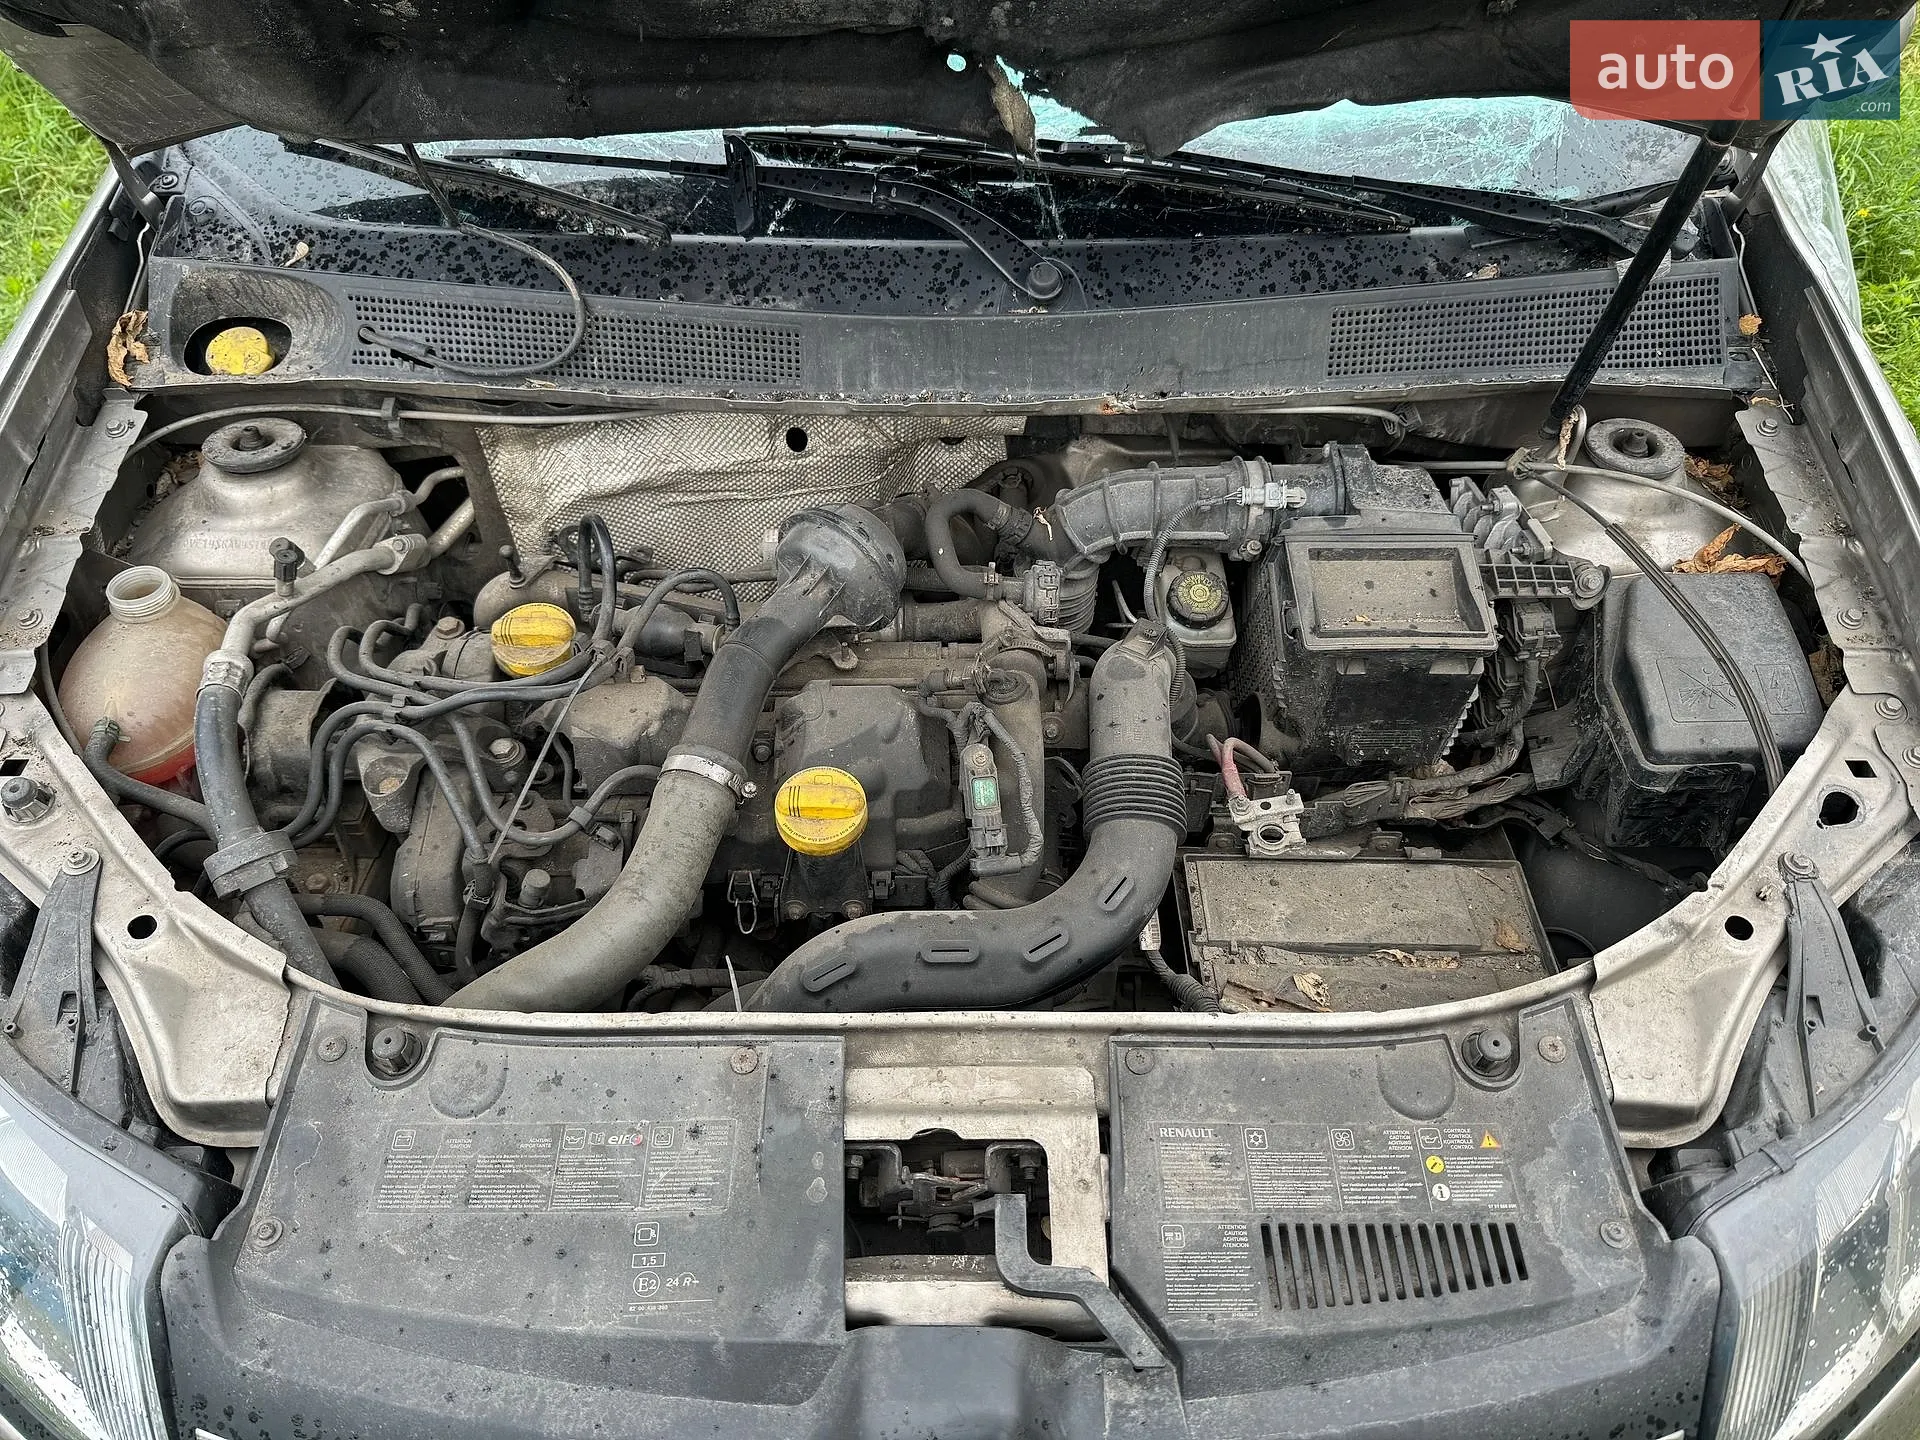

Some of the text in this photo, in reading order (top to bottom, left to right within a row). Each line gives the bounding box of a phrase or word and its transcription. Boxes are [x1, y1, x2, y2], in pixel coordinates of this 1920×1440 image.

[1159, 1127, 1214, 1138] RENAULT
[607, 1134, 630, 1145] elf
[641, 1256, 657, 1267] 1,5
[637, 1277, 657, 1292] E2
[665, 1277, 680, 1288] 24
